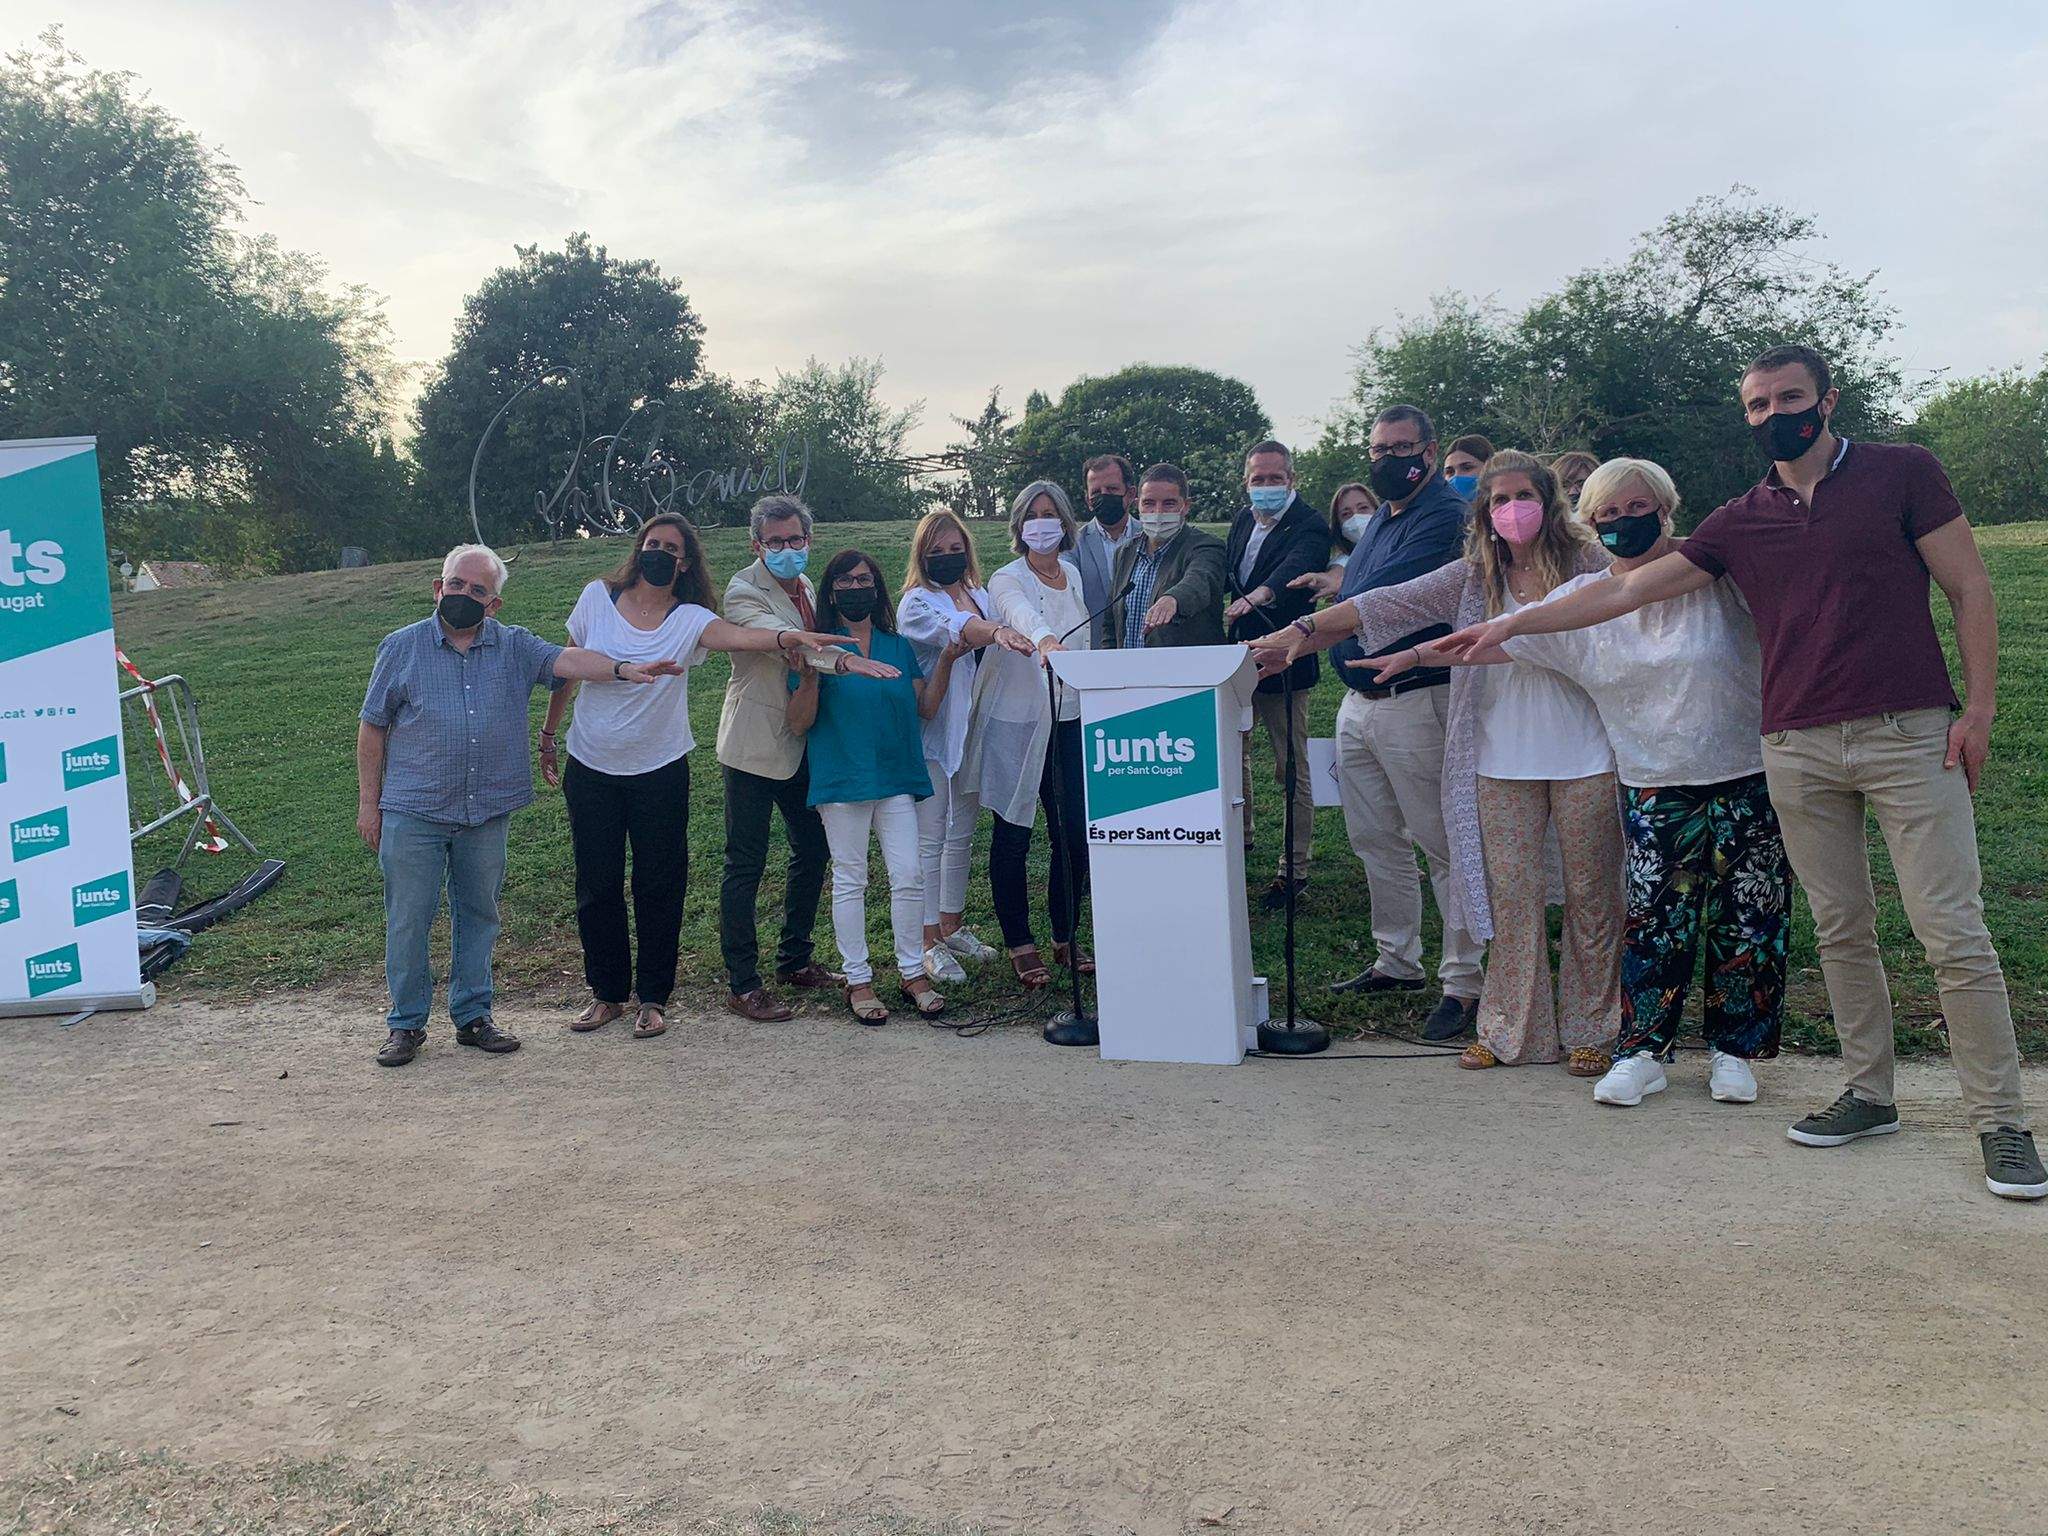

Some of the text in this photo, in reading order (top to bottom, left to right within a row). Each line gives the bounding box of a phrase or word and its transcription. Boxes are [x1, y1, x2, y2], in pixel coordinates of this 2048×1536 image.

[1093, 728, 1196, 772] junts
[65, 752, 110, 772] junts
[1108, 765, 1183, 777] per Sant Cugat
[14, 823, 60, 843] junts
[1088, 824, 1221, 844] És per Sant Cugat
[75, 887, 120, 907] junts
[29, 959, 72, 978] junts
